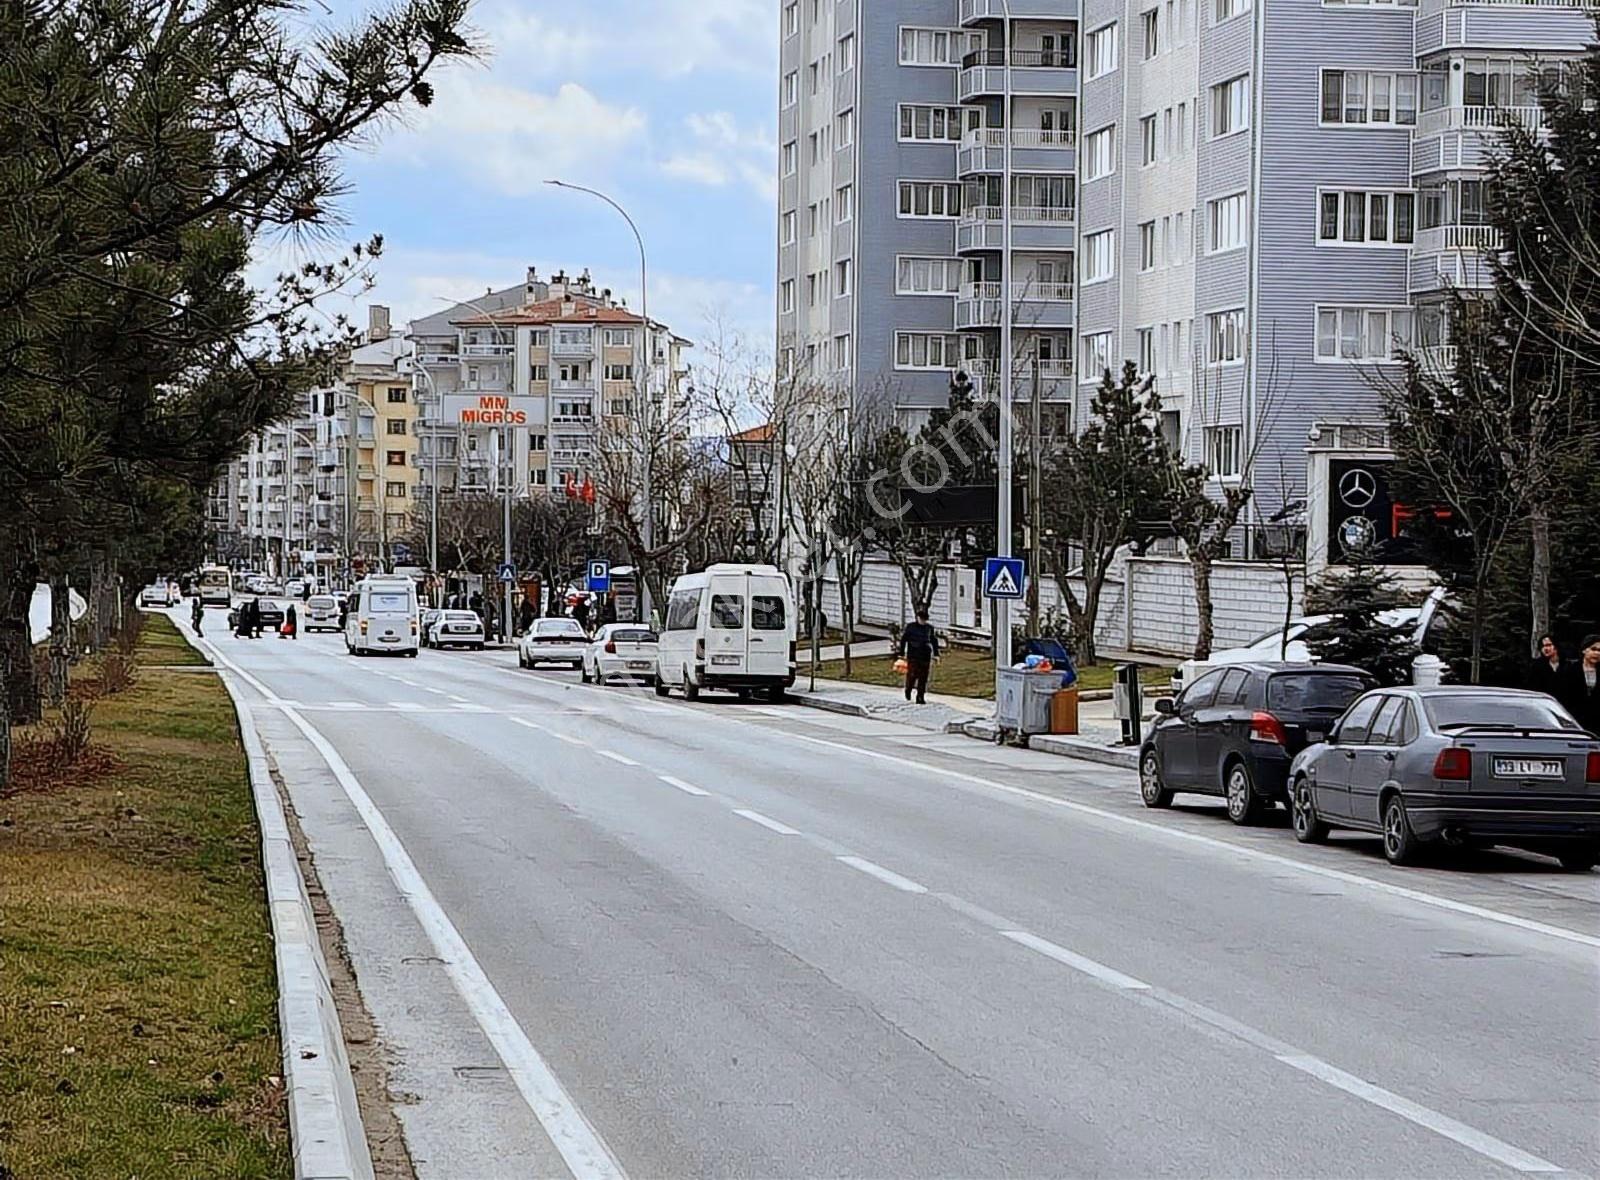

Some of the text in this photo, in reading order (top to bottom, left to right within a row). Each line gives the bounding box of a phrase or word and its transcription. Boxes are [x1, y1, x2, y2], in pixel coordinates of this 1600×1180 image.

[479, 396, 510, 410] MM
[461, 409, 527, 425] MIGROS
[593, 564, 604, 577] D
